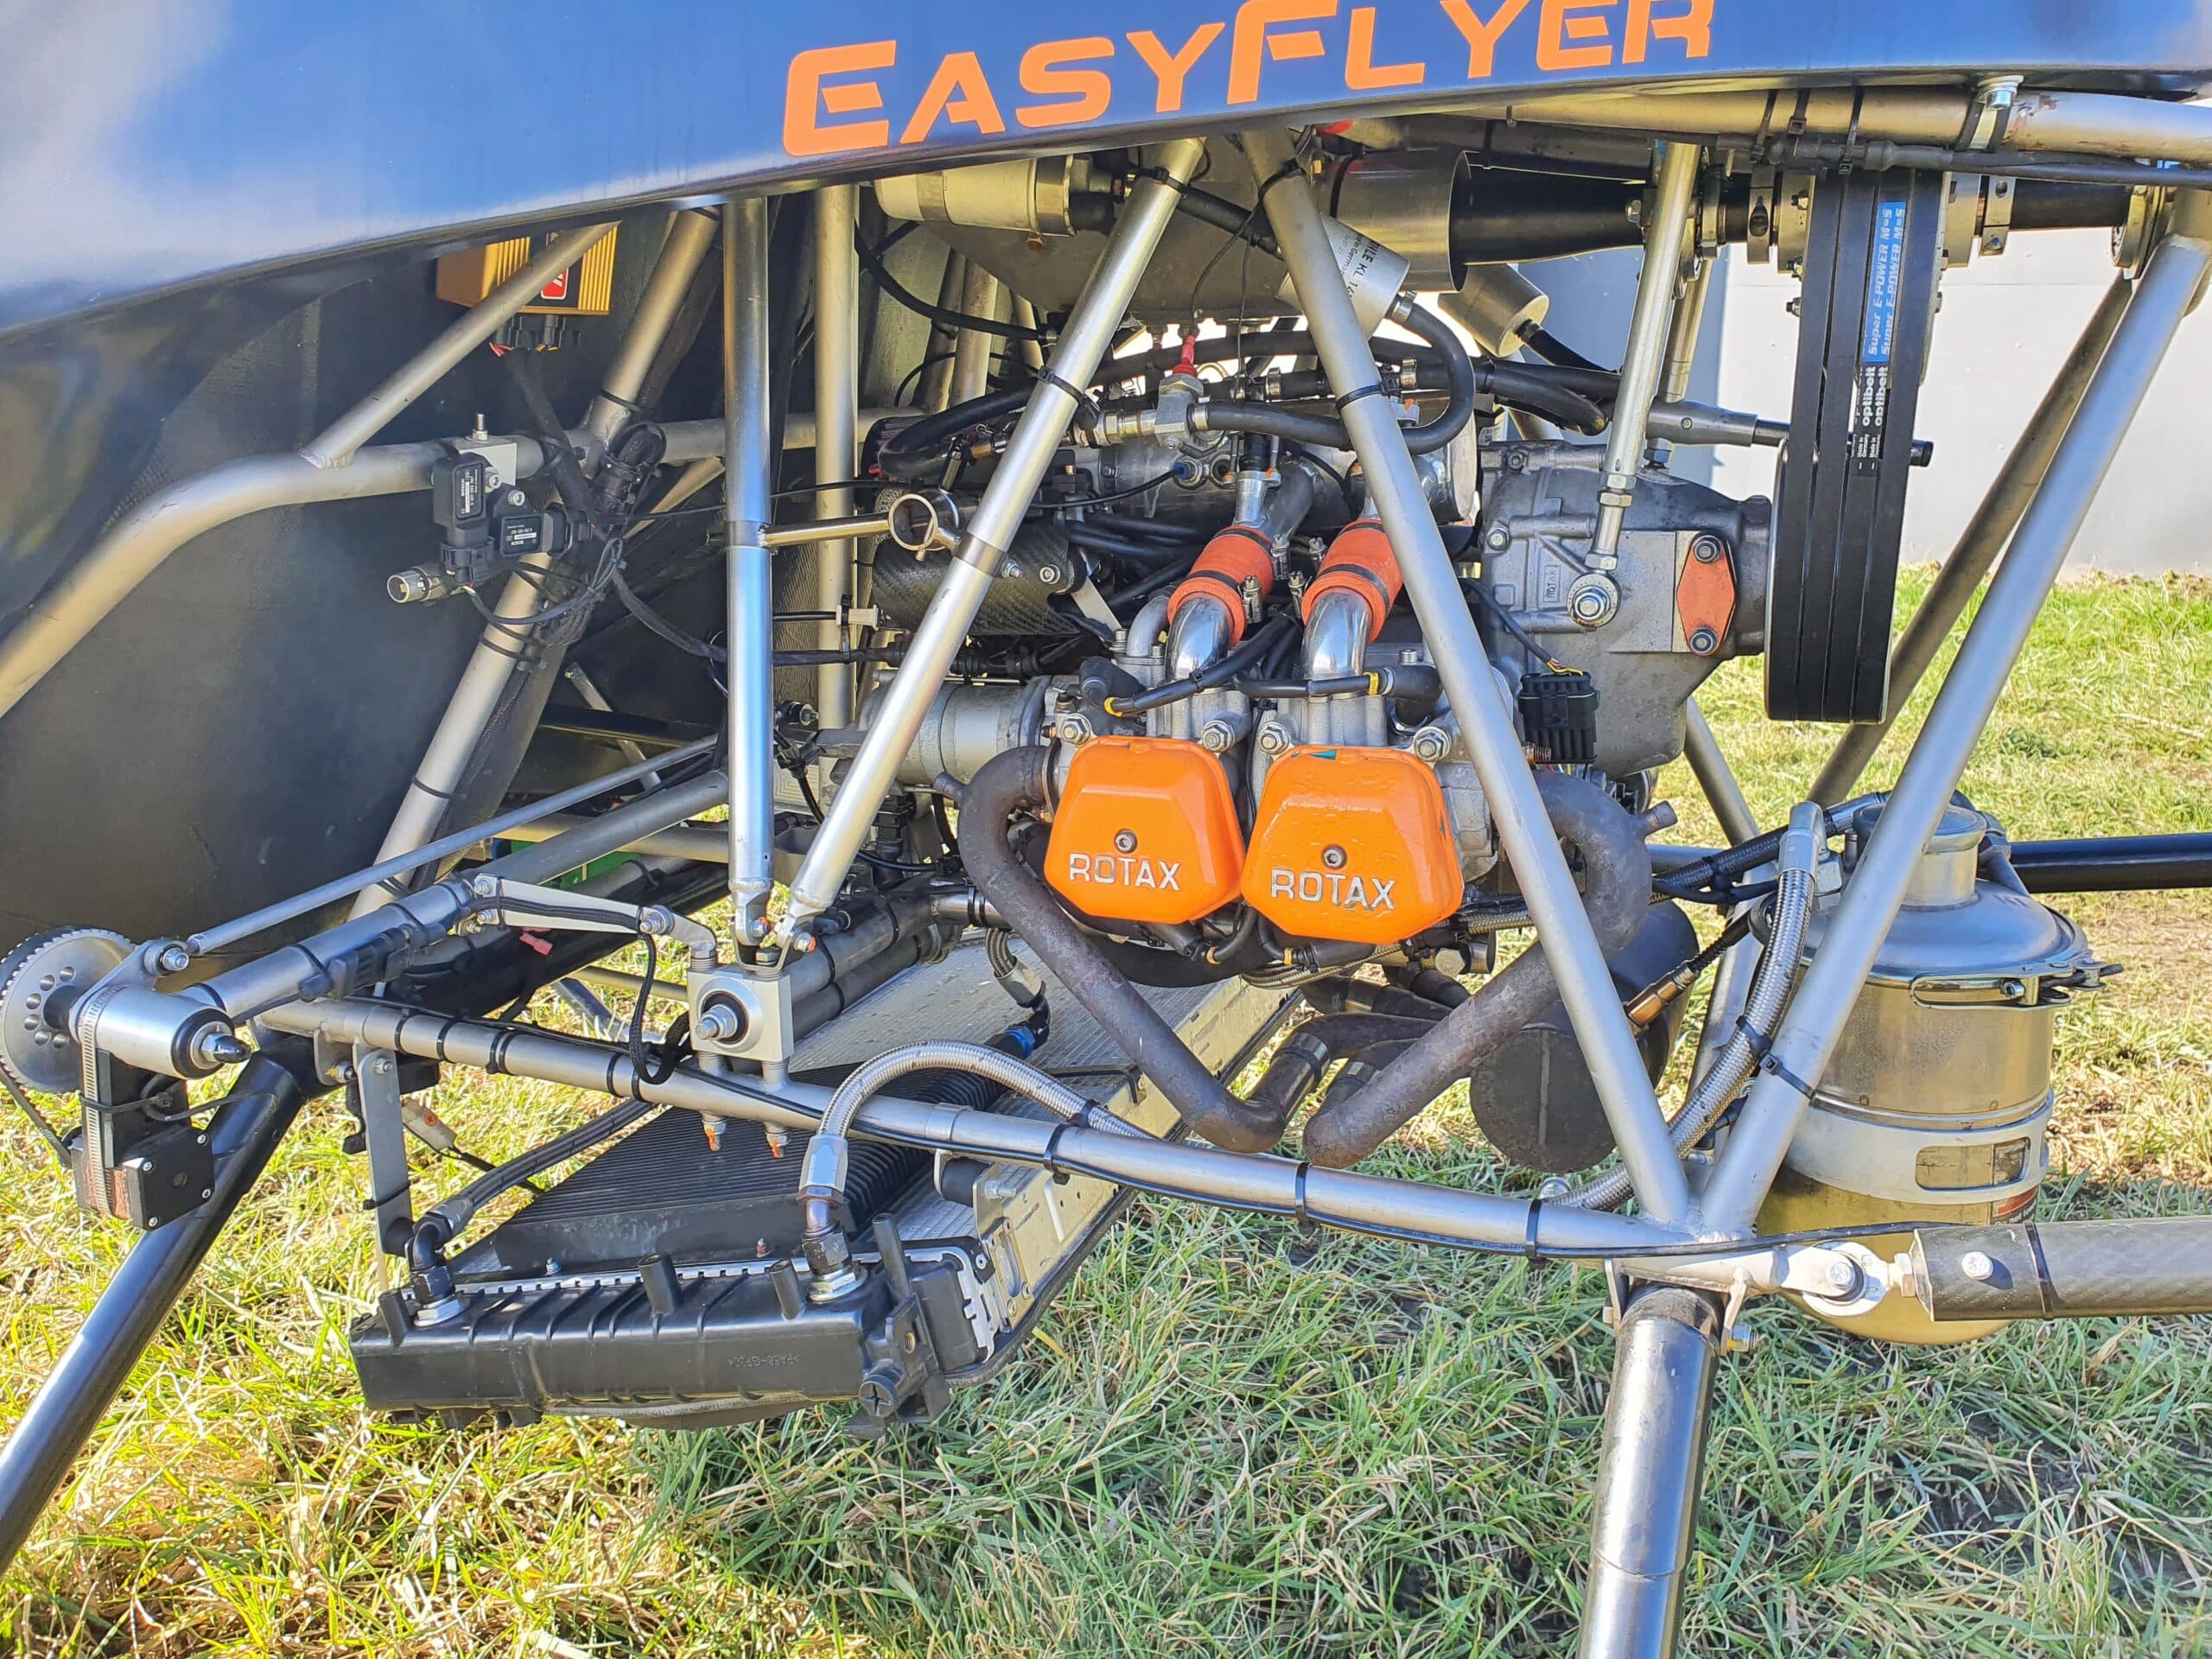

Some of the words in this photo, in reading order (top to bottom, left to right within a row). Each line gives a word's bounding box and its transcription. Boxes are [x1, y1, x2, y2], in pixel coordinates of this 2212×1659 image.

[1353, 263, 1368, 277] KL
[1872, 244, 1889, 308] E-POWER
[1867, 313, 1882, 356] Super
[1862, 365, 1876, 427] optibelt
[1875, 365, 1889, 427] optibelt
[1070, 853, 1180, 891] ROTAX
[1271, 868, 1395, 910] ROTAX
